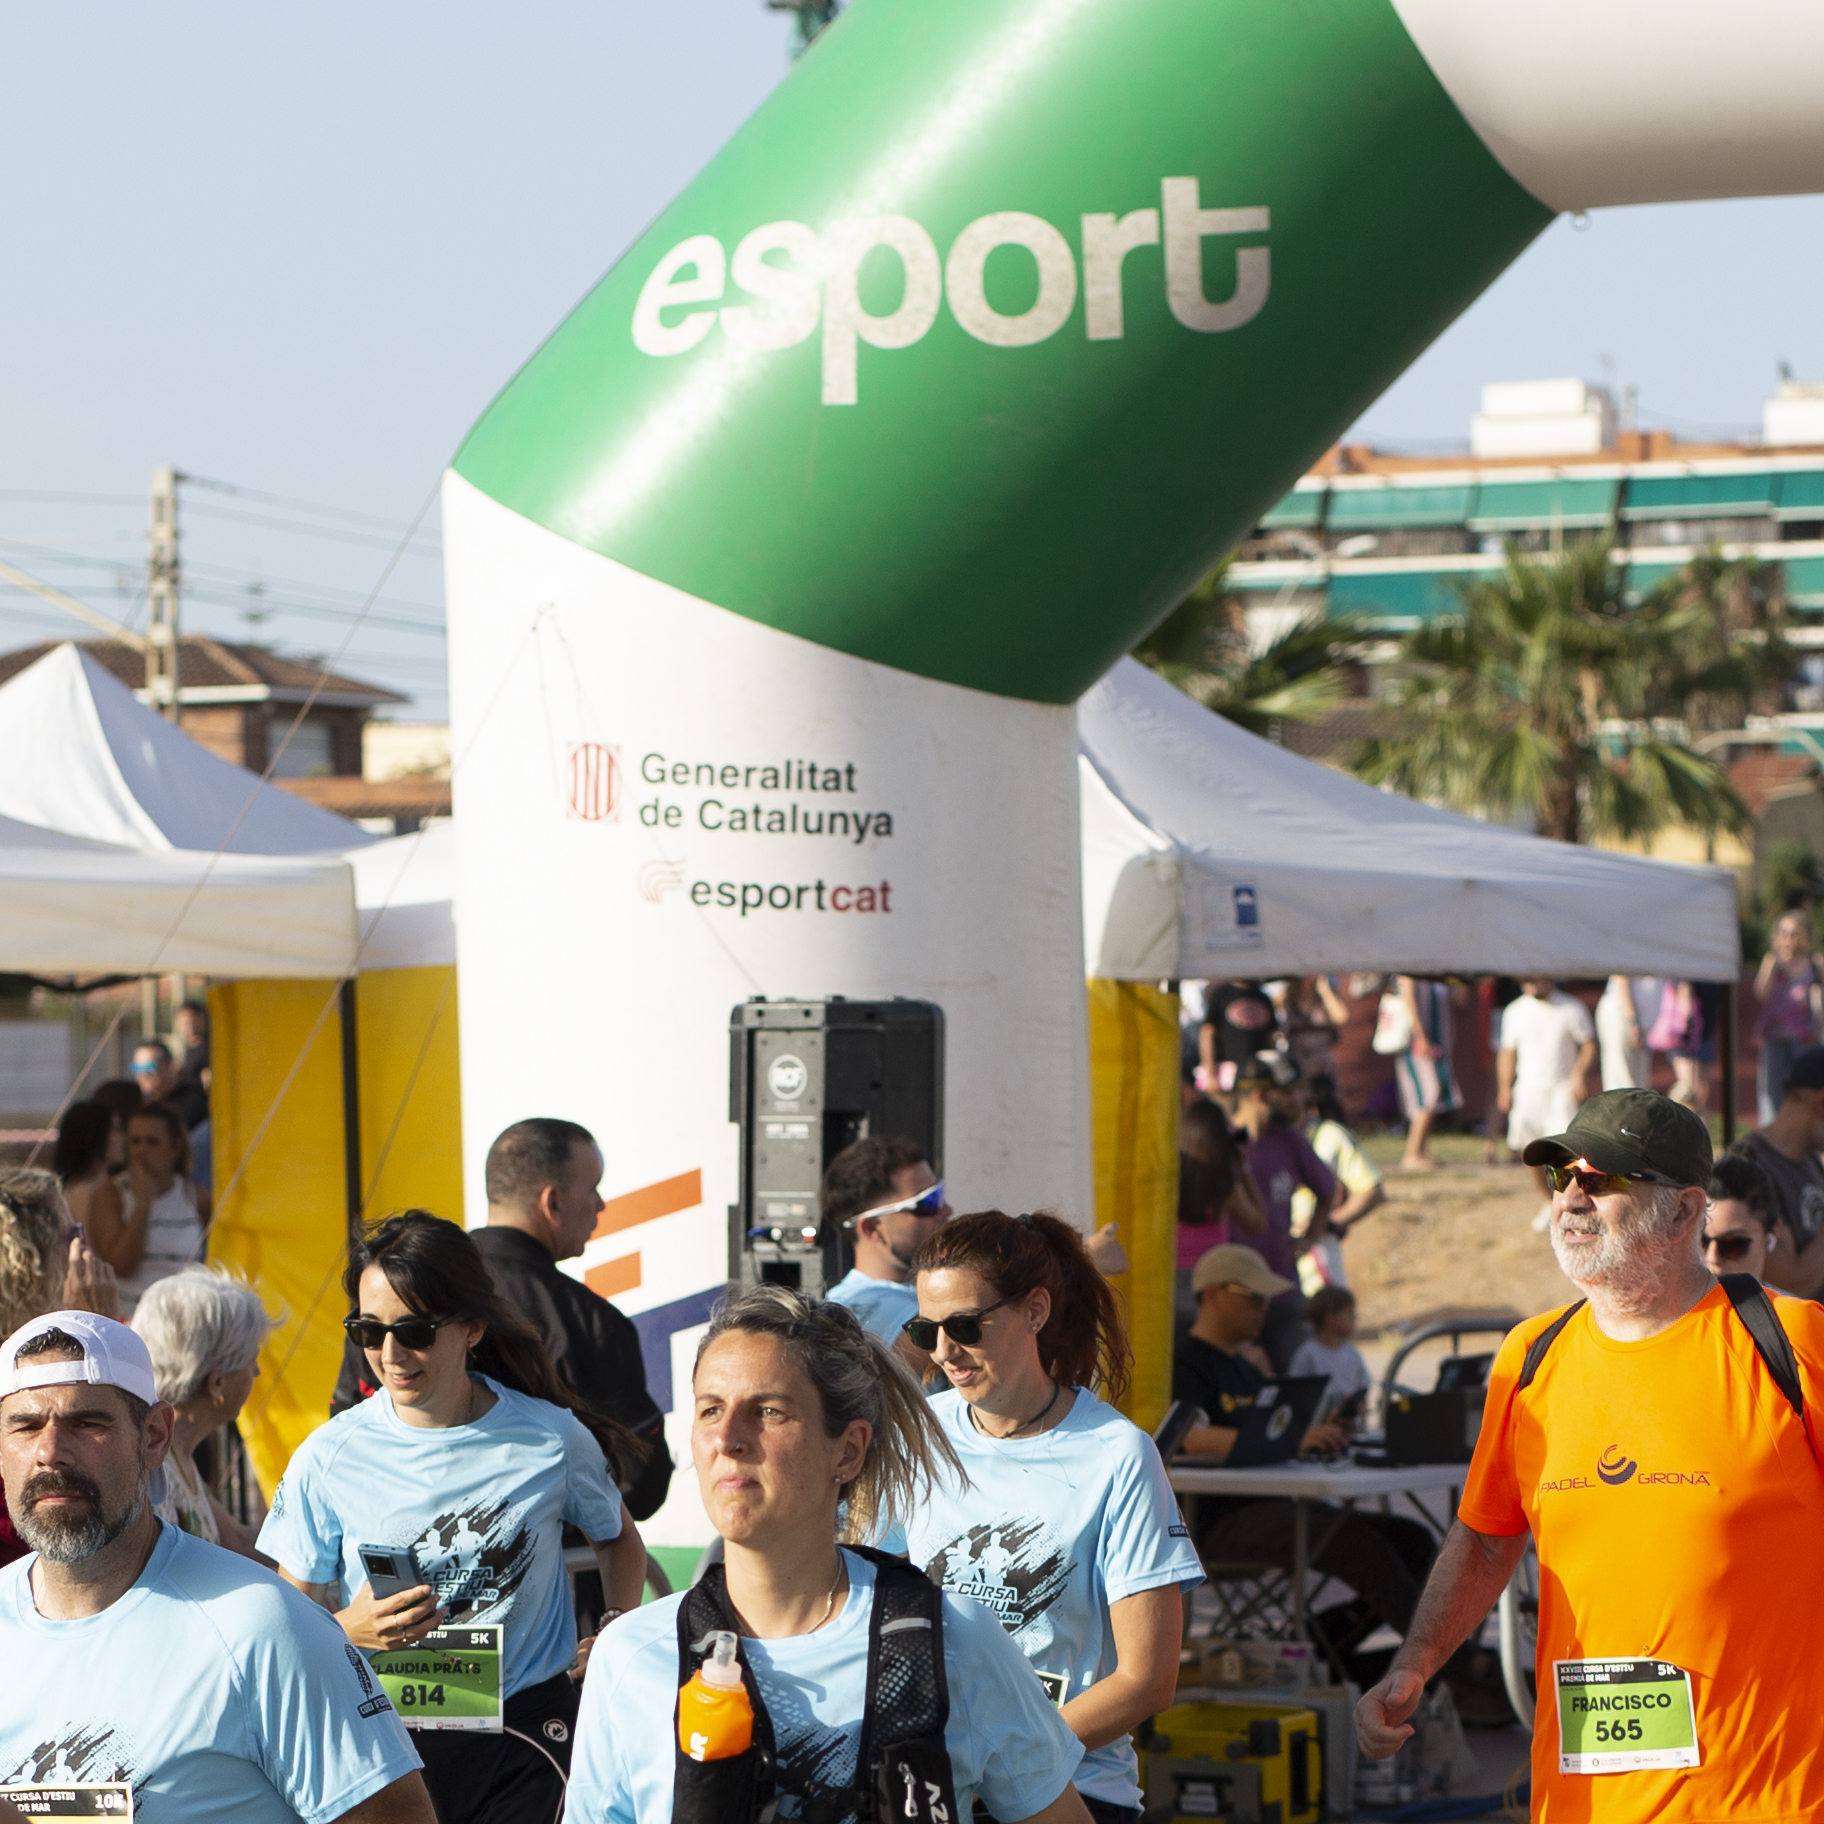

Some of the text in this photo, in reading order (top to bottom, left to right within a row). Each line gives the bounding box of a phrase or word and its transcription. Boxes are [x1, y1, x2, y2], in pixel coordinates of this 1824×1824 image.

[632, 176, 1272, 406] esport
[641, 752, 858, 793] Generalitat
[639, 797, 894, 845] de Catalunya
[690, 878, 893, 917] esportcat
[1540, 1472, 1712, 1494] PADEL GIRONA
[432, 1567, 494, 1582] CURSA
[434, 1580, 485, 1594] ESTIU
[958, 1582, 1016, 1600] CURSA
[470, 1632, 490, 1645] 5K
[433, 1662, 482, 1675] PRATS
[1583, 1665, 1604, 1673] CURSA
[1605, 1664, 1635, 1672] D'ESTIU
[1657, 1664, 1677, 1676] 5K
[1586, 1674, 1594, 1682] DE
[1595, 1674, 1611, 1682] MAR
[400, 1684, 446, 1706] 814
[1572, 1693, 1672, 1713] FRANCISCO
[1595, 1718, 1643, 1742] 565
[9, 1791, 42, 1802] CURSA
[42, 1791, 76, 1801] D'ESTIU
[95, 1793, 125, 1809] 10K
[17, 1803, 52, 1812] DE MAR
